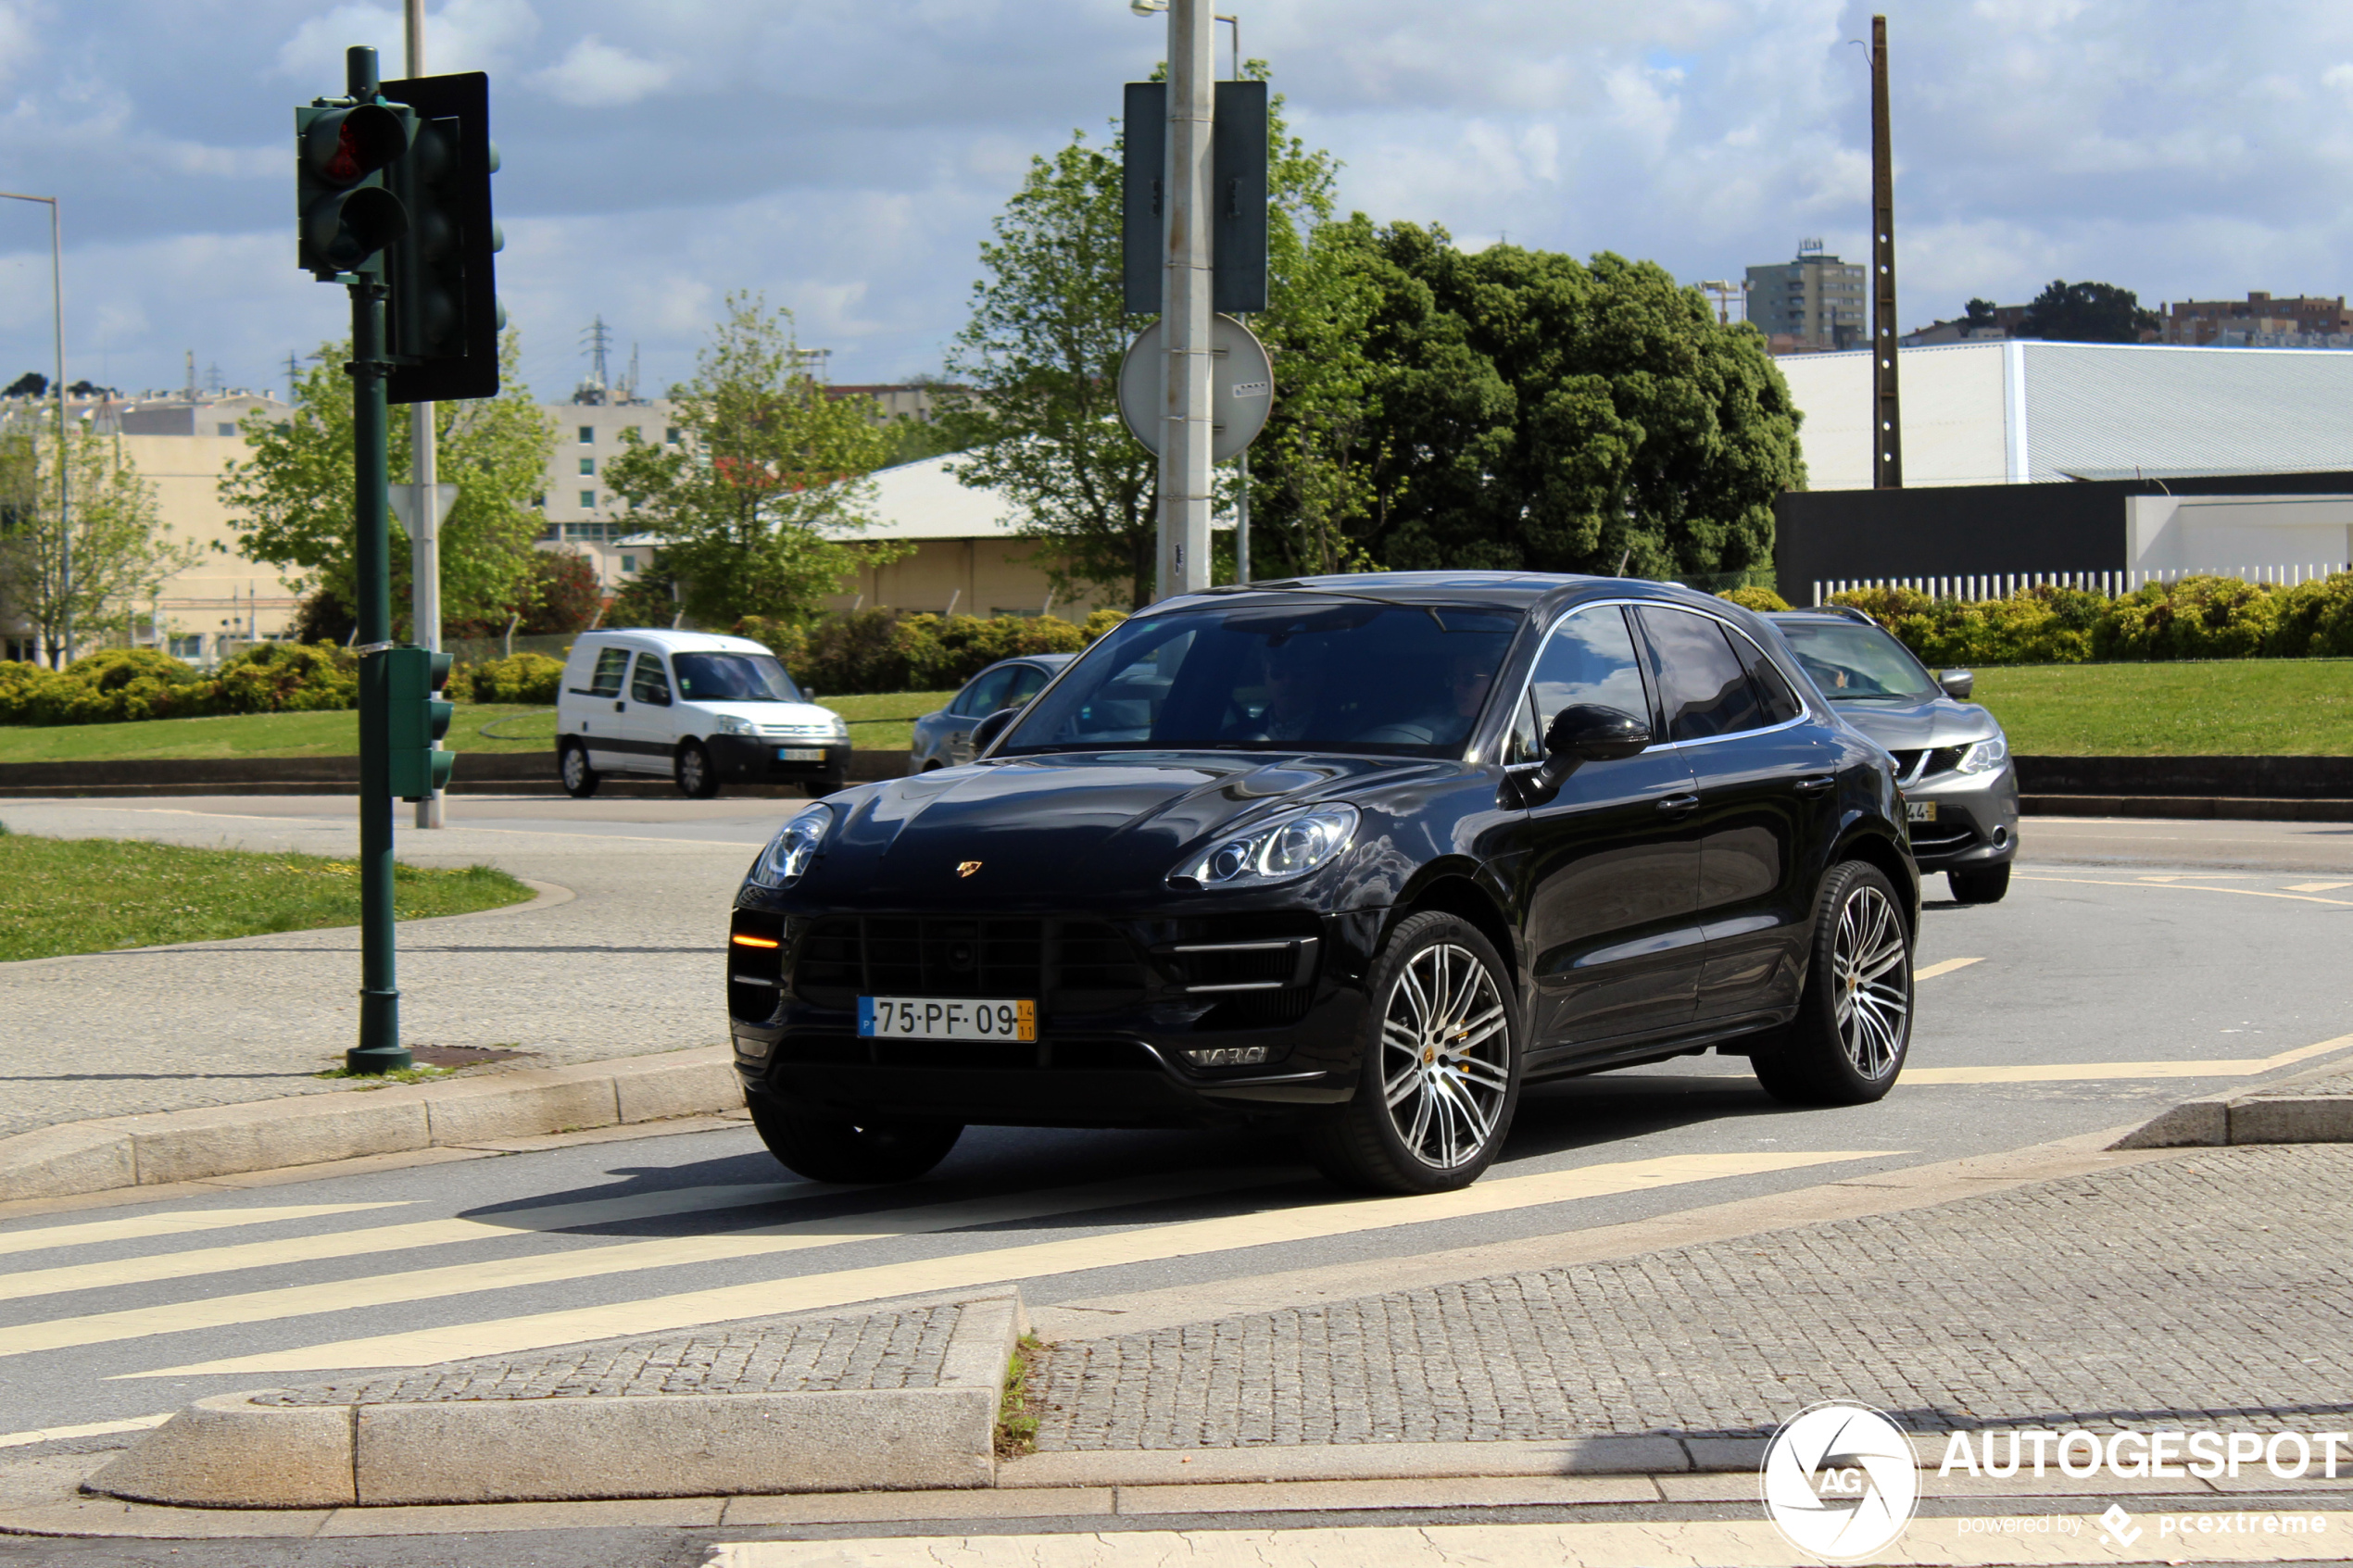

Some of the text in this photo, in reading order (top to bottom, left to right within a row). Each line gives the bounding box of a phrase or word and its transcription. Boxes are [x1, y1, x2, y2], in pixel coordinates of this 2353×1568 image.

[1018, 1005, 1033, 1017] 14
[863, 1020, 871, 1030] P
[1020, 1026, 1032, 1036] 11
